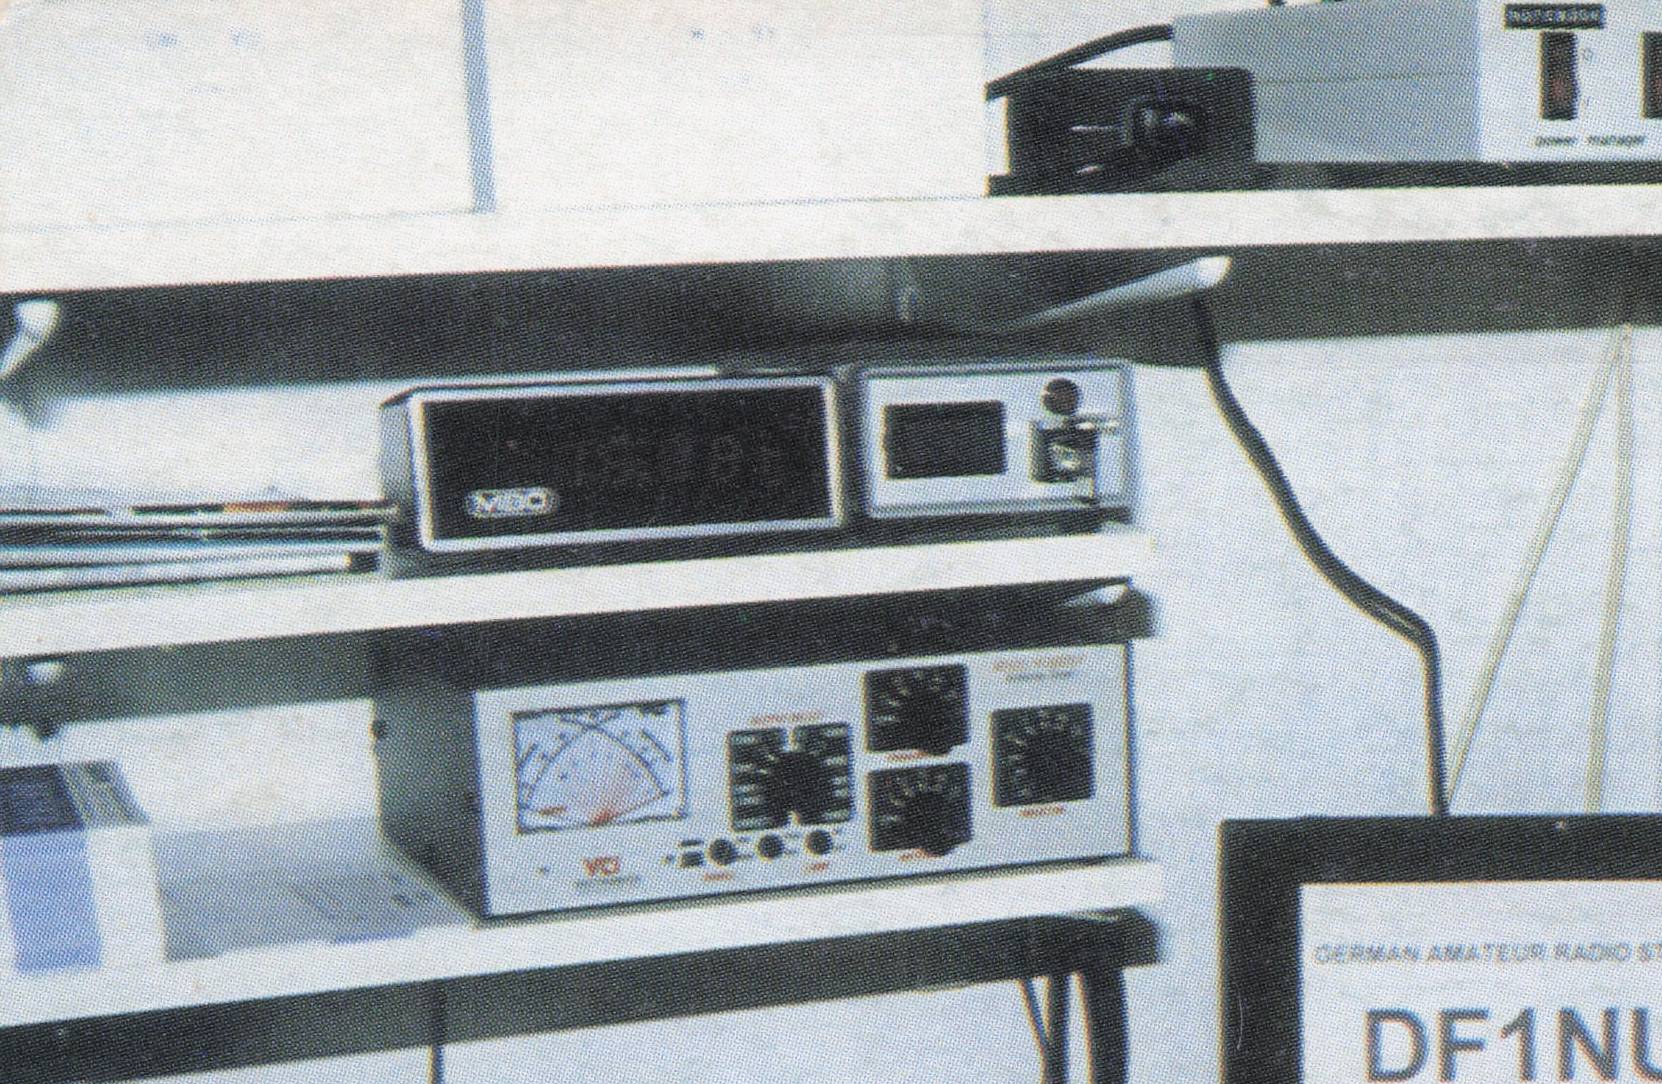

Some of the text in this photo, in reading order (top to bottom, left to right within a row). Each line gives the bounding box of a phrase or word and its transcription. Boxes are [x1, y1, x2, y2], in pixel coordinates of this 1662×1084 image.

[1313, 943, 1420, 963] GERMAN
[1426, 942, 1545, 963] AMATEUR
[1554, 942, 1628, 963] RADIO
